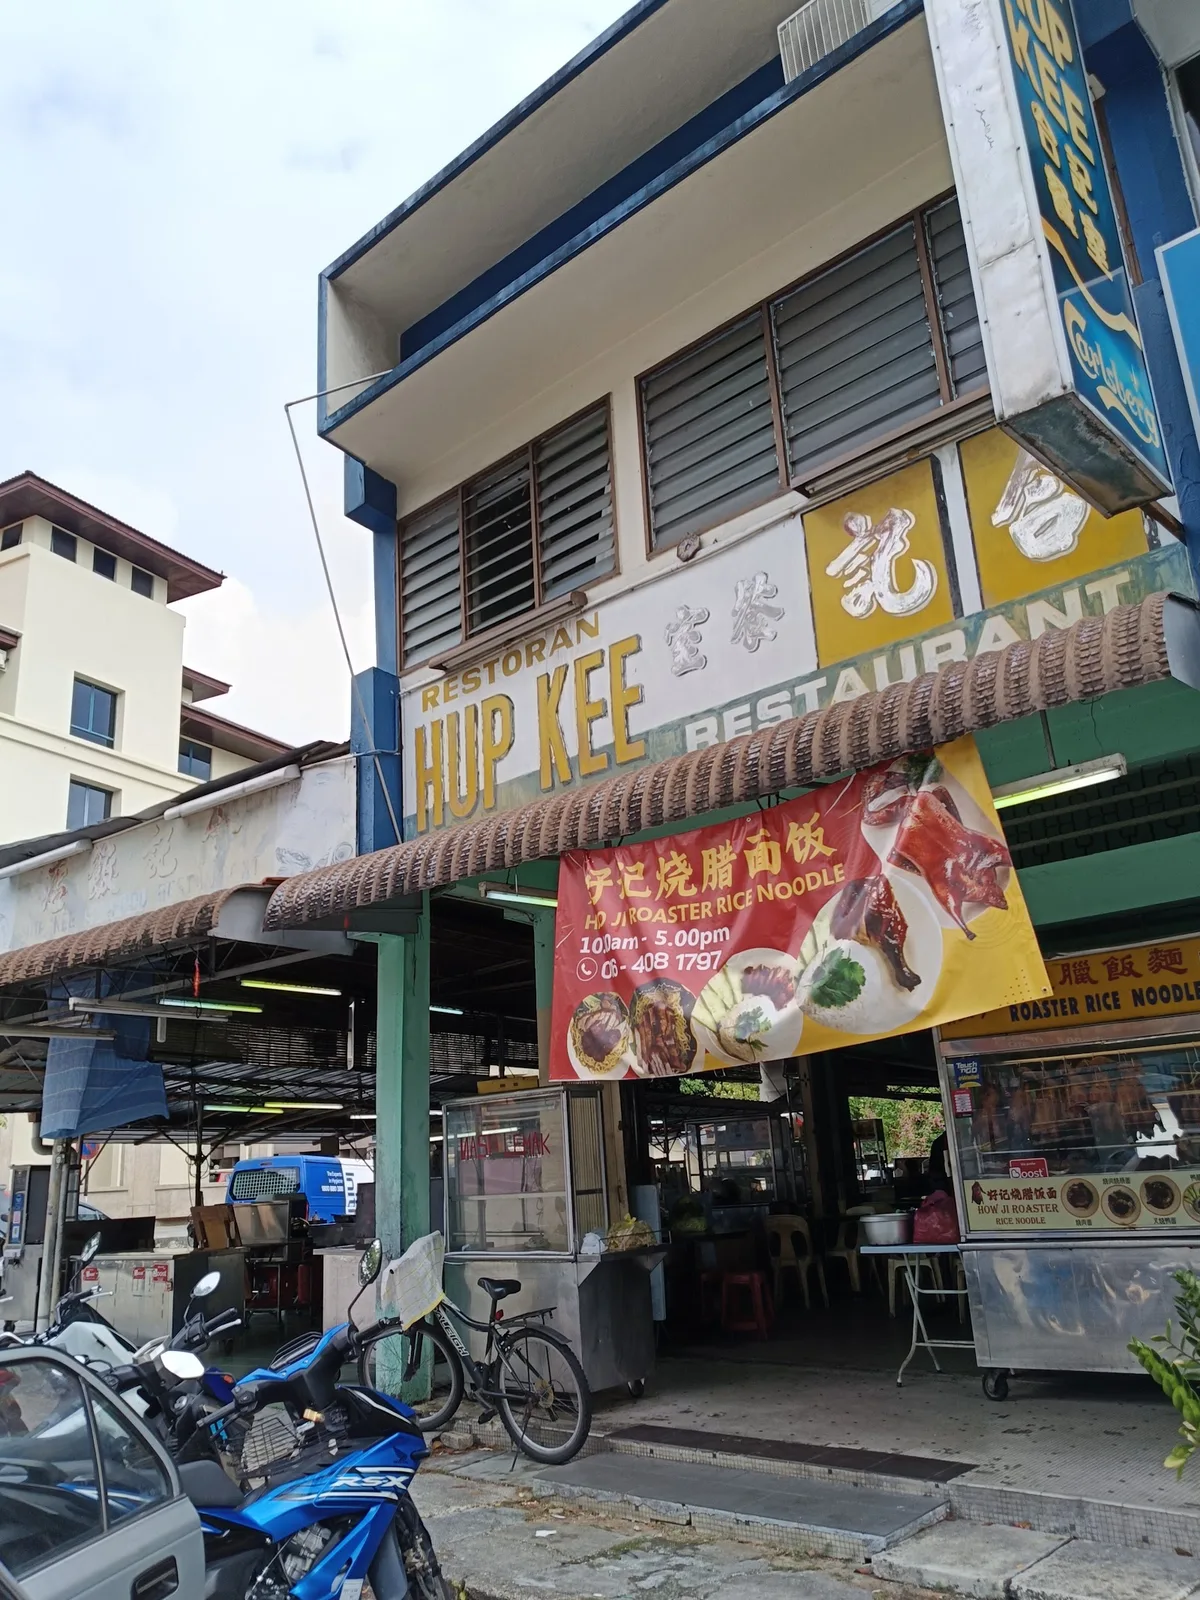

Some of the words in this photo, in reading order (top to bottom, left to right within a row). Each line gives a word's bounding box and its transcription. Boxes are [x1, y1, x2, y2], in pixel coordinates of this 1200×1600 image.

[1016, 0, 1073, 71] UP
[1005, 0, 1095, 166] KEE
[1064, 299, 1160, 448] Carlsberg
[421, 611, 599, 713] RESTORAN
[685, 570, 1132, 751] RESTAURANT
[415, 693, 515, 833] HUP
[536, 634, 647, 792] KEE
[628, 901, 712, 925] ROASTER
[716, 888, 753, 915] RICE
[757, 863, 845, 902] NOODLE
[631, 951, 669, 974] 408
[676, 950, 722, 971] 1797
[655, 926, 730, 951] 5.00pm
[1009, 997, 1080, 1023] ROASTER
[1086, 990, 1121, 1013] RICE
[1131, 980, 1200, 1008] NOODLE
[978, 1204, 999, 1214] HOW
[1001, 1205, 1010, 1214] JI
[1012, 1204, 1059, 1214] ROASTER
[996, 1217, 1014, 1225] RICE
[1015, 1217, 1046, 1225] NOODLE
[330, 1475, 409, 1490] RSX
